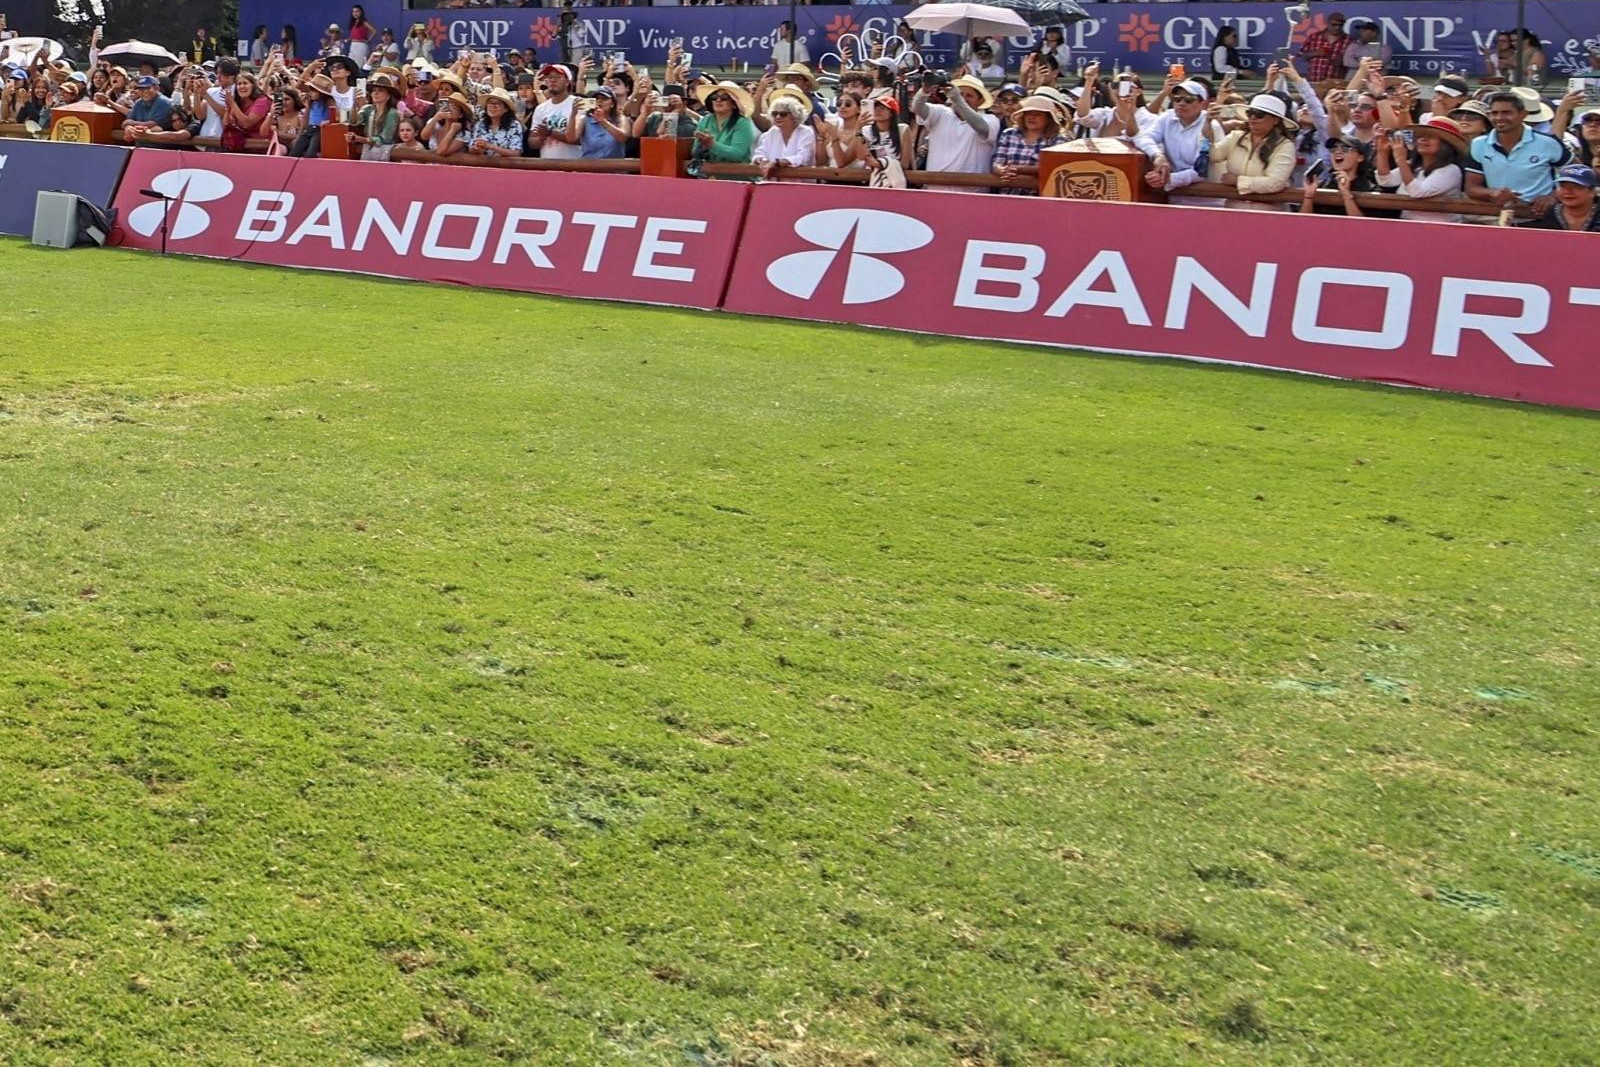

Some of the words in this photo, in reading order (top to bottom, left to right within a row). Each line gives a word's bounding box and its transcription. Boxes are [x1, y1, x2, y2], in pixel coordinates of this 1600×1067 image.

[449, 20, 509, 46] GNP
[582, 19, 626, 46] NP
[692, 35, 709, 49] es
[236, 189, 708, 282] BANORTE
